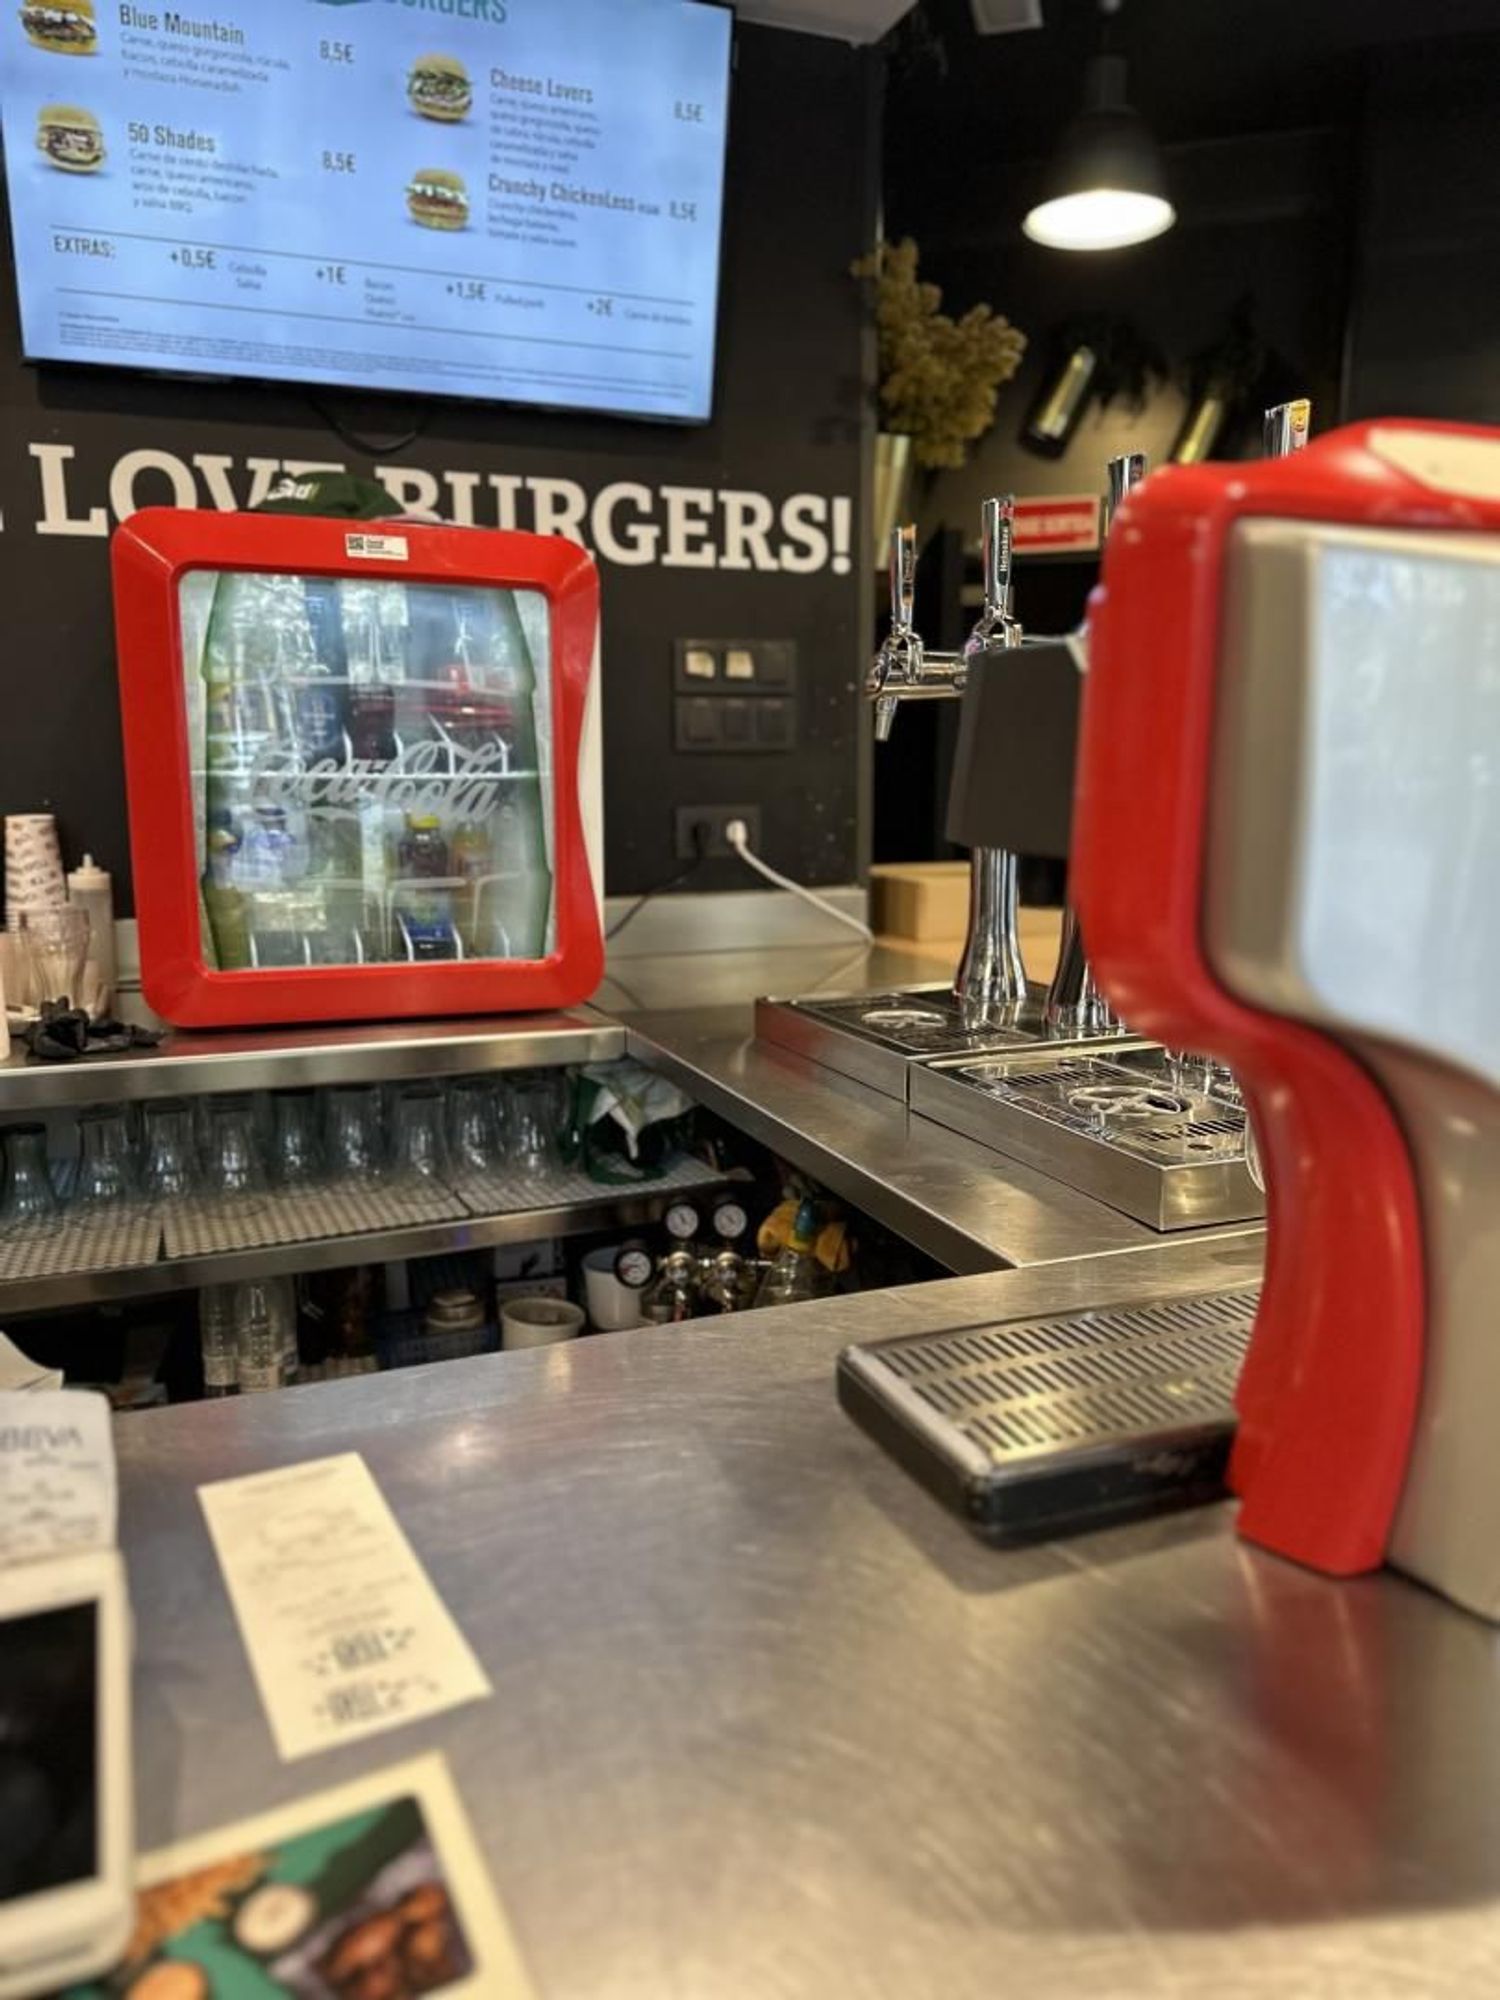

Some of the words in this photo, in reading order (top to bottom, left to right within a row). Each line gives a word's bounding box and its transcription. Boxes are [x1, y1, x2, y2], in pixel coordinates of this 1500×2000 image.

[119, 4, 158, 30] Blue
[165, 12, 245, 45] Mountain
[490, 67, 542, 95] Cheese
[547, 77, 593, 104] Lovers
[128, 122, 149, 144] 50
[154, 125, 216, 153] Shades
[323, 150, 356, 173] 8,5€
[488, 173, 546, 202] Crunchy
[54, 235, 116, 260] EXTRAS:
[170, 248, 216, 271] +0,5€
[315, 266, 347, 285] +1€
[29, 443, 345, 536] LOV
[375, 466, 852, 575] BURGERS!
